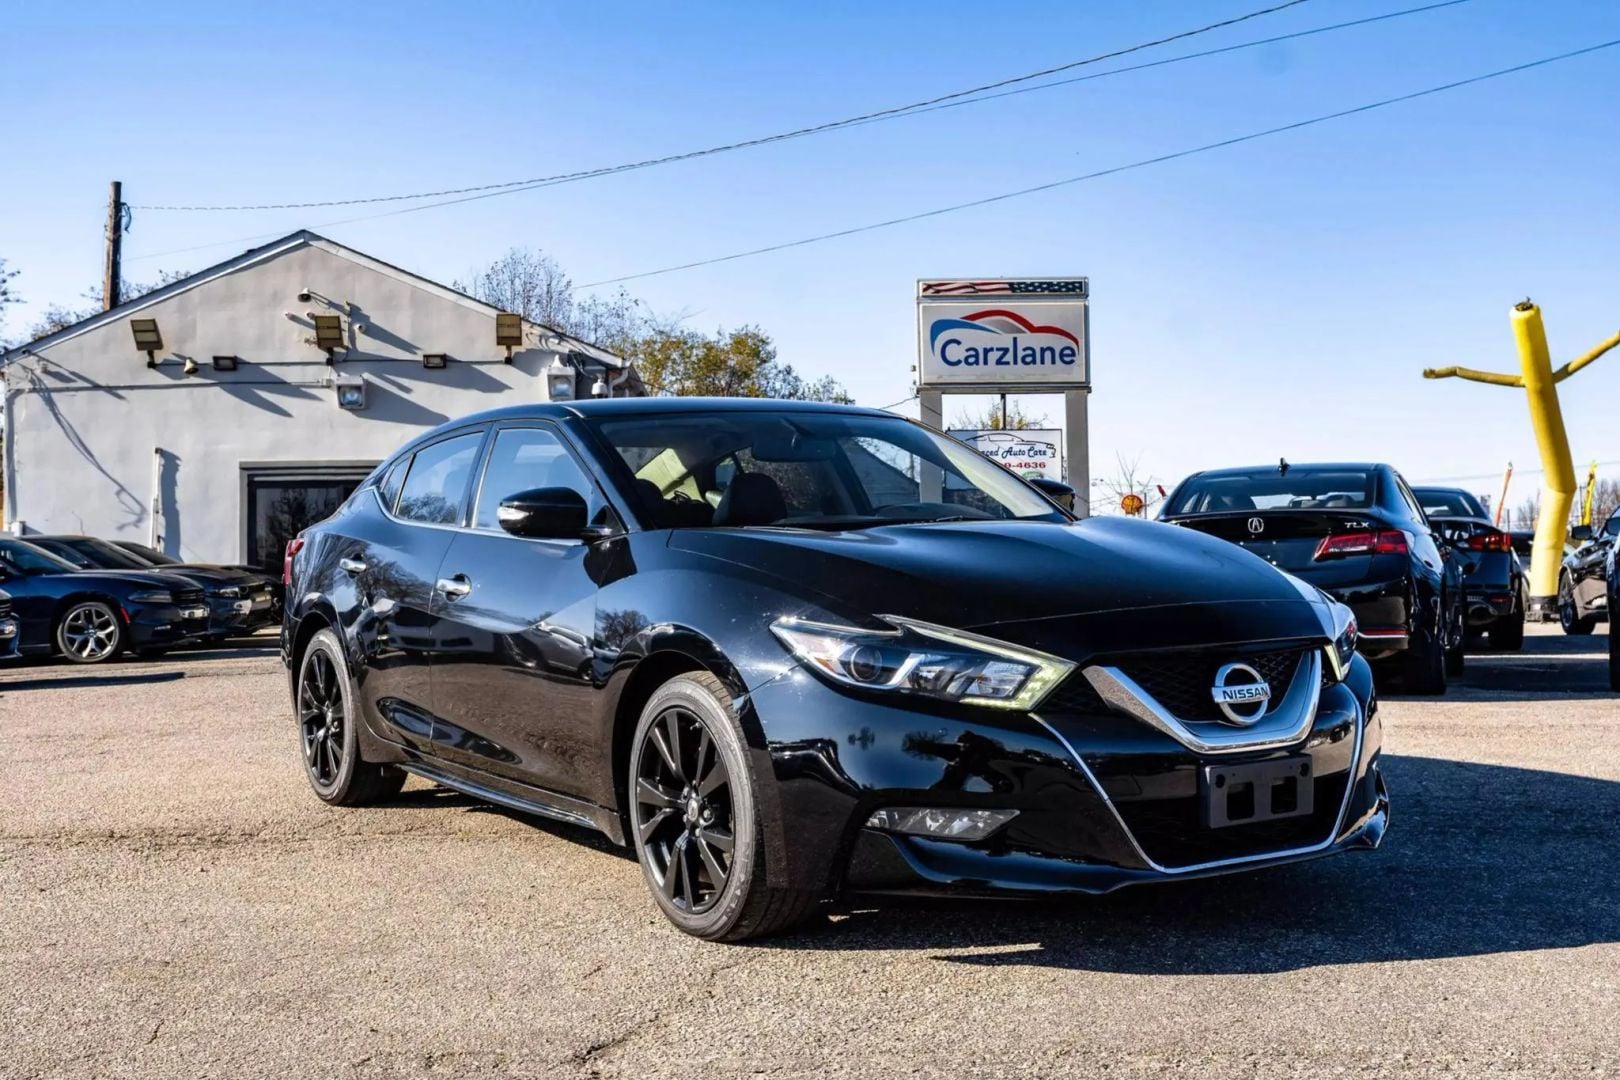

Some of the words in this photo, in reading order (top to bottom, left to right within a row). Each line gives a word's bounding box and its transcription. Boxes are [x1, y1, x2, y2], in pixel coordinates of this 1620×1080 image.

[940, 337, 1077, 367] Carzlane
[1001, 446, 1026, 459] Auto
[1027, 446, 1047, 458] Care
[1344, 521, 1369, 529] TLX
[1222, 686, 1269, 700] NISSAN
